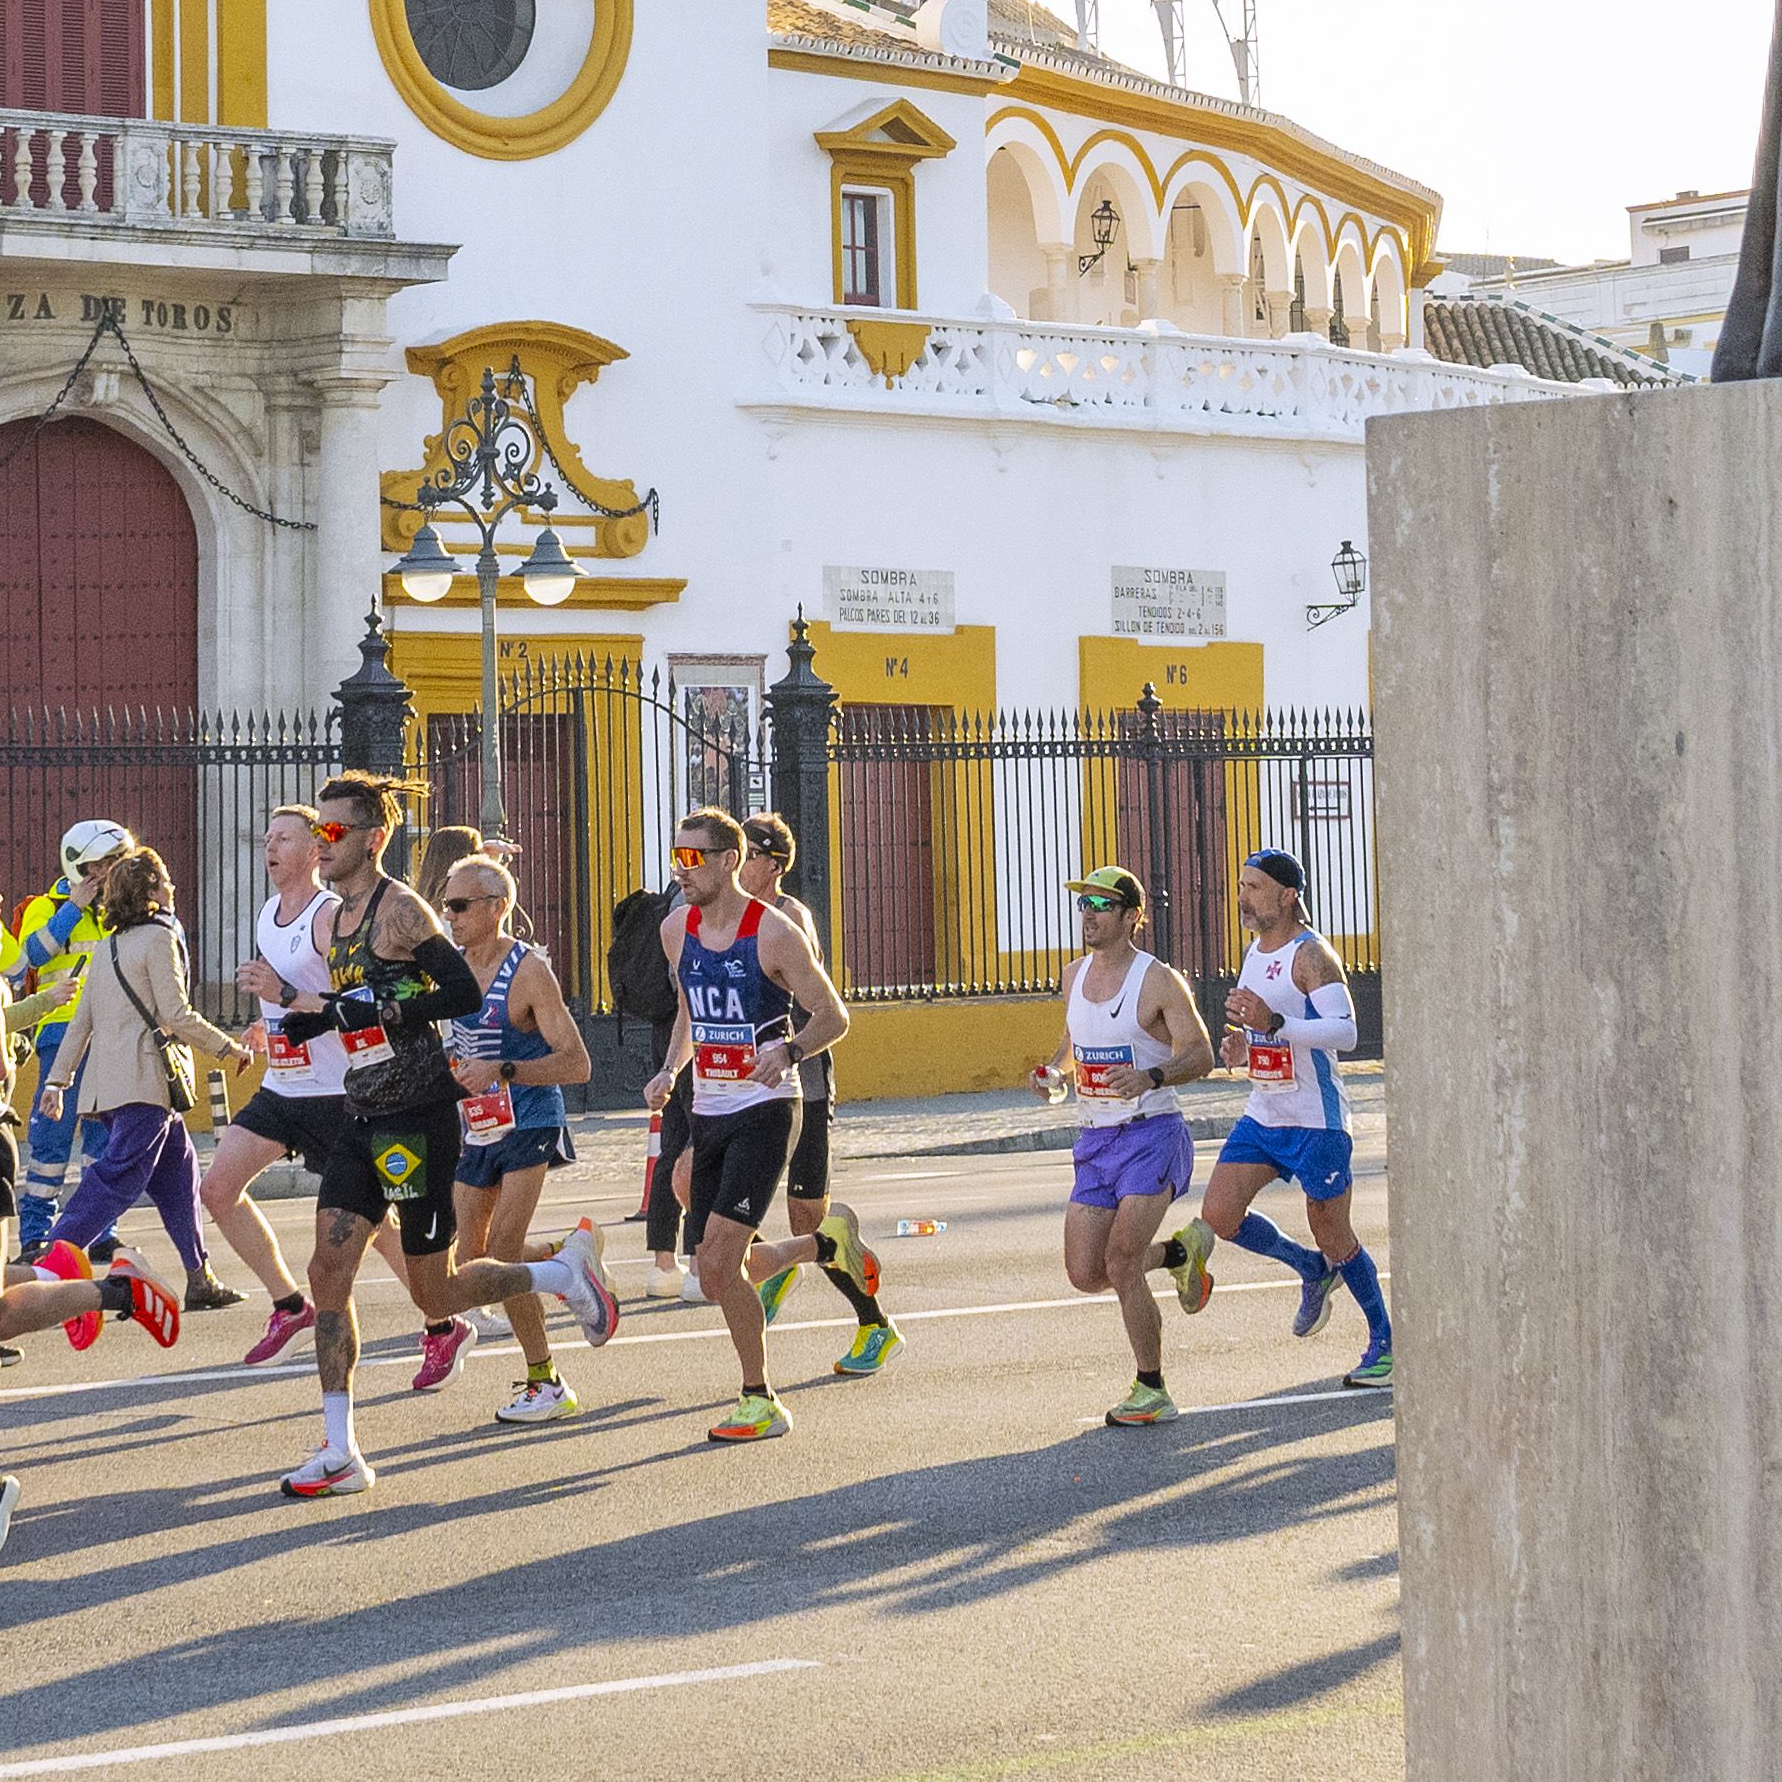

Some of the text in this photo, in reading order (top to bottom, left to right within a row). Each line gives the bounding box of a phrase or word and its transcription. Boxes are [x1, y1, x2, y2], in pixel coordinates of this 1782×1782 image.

[79, 293, 126, 325] DE
[141, 298, 233, 334] TOROS
[861, 569, 917, 586] SOMBRA
[1144, 569, 1194, 585] SOMBRA
[839, 588, 878, 603] SOMBRA
[887, 590, 912, 604] ALTA
[919, 592, 925, 604] 4
[933, 592, 939, 605] 6
[1114, 586, 1157, 600] BARRERAS
[839, 607, 864, 622] PALCOS
[867, 608, 890, 624] PARES
[893, 609, 907, 624] DEL
[910, 610, 919, 625] 12
[928, 611, 940, 626] 36
[1138, 605, 1172, 619] TENDIDOS
[1143, 621, 1153, 633] DE
[1156, 622, 1185, 635] TENDIDO
[518, 641, 528, 658] 2
[900, 657, 908, 679] 4
[1179, 664, 1188, 685] 6
[688, 986, 746, 1021] NCA
[708, 1030, 744, 1041] ZURICH
[1084, 1050, 1124, 1061] ZURICH
